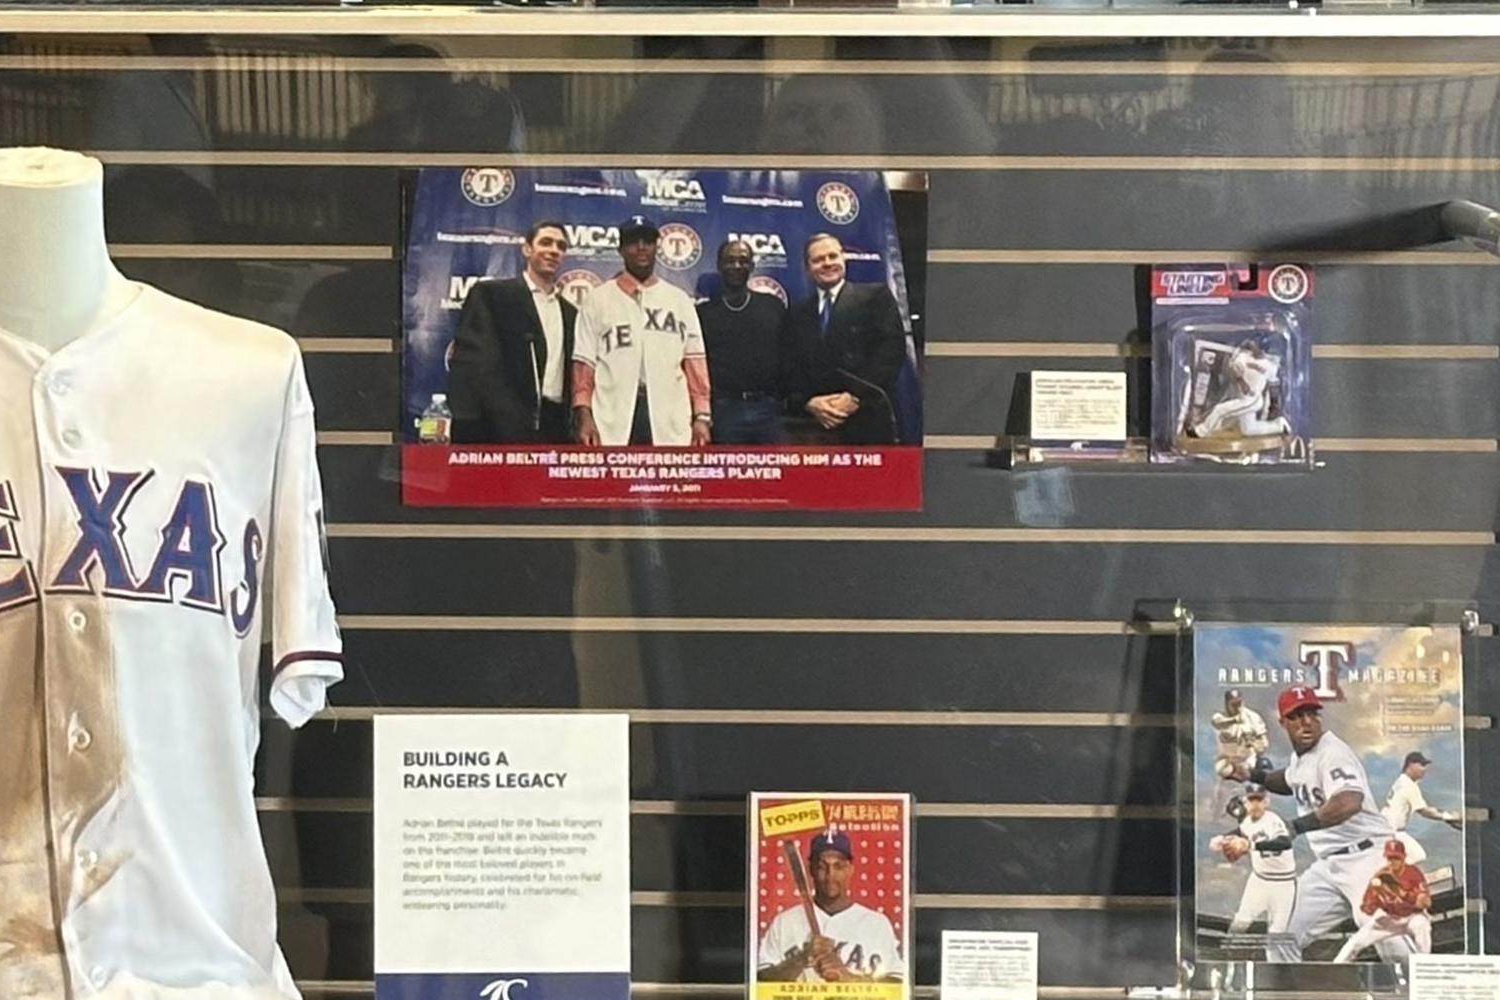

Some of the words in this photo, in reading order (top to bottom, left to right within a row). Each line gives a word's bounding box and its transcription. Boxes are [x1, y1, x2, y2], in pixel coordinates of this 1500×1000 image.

[647, 178, 706, 200] MCA
[448, 452, 503, 465] ADRIAN
[560, 453, 604, 465] PRESS
[607, 453, 700, 466] CONFERENCE
[703, 453, 800, 466] INTRODUCING
[803, 454, 829, 466] HIM
[832, 454, 851, 466] AS
[854, 454, 883, 466] THE
[548, 467, 608, 478] NEWEST
[610, 467, 657, 479] TEXAS
[659, 467, 725, 479] RANGERS
[727, 467, 782, 479] PLAYER
[1218, 667, 1305, 683] RANGERS
[1300, 643, 1353, 699] T
[403, 751, 490, 767] BUILDING
[495, 751, 509, 767] A
[403, 773, 490, 788] RANGERS
[495, 773, 567, 788] LEGACY
[764, 809, 821, 828] TOPPS
[780, 984, 828, 993] ADRIAN
